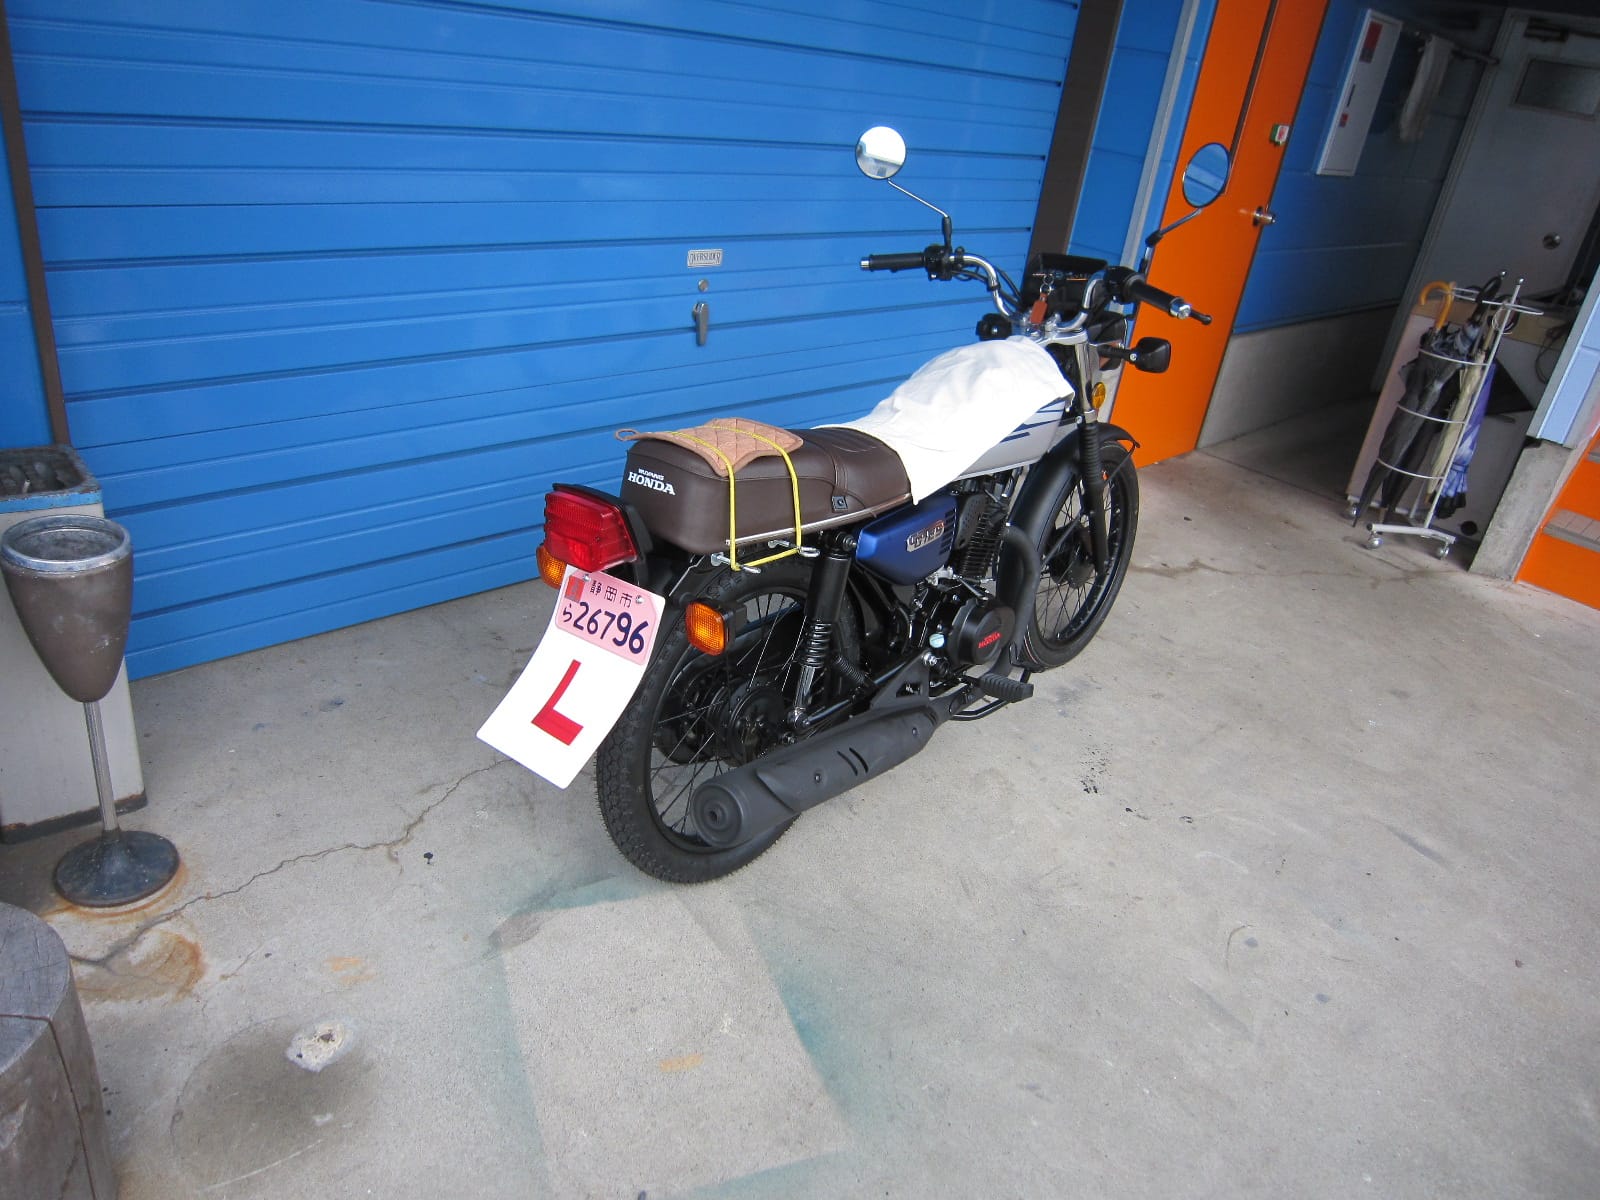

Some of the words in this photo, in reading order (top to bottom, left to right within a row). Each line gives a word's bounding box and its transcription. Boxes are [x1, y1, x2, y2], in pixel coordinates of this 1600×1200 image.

[627, 471, 676, 496] HONDA
[590, 579, 633, 608] 静岡市
[573, 601, 649, 655] 26796
[531, 658, 584, 746] L
